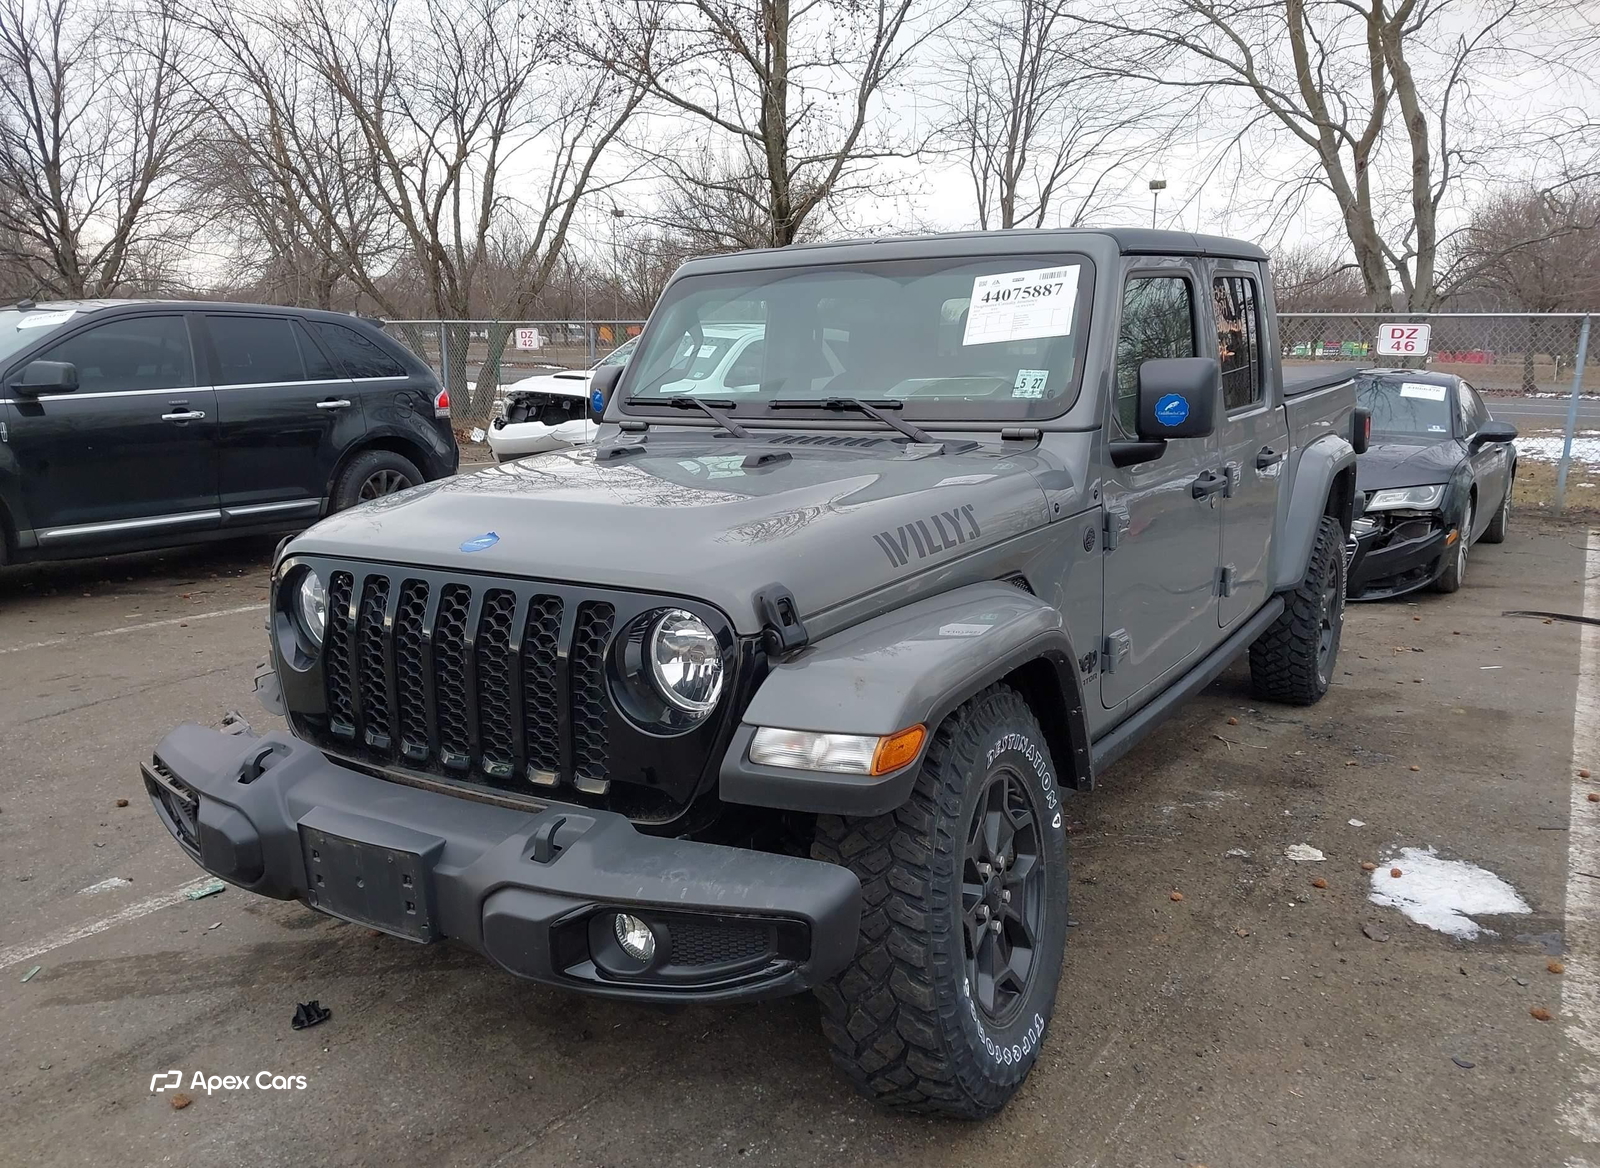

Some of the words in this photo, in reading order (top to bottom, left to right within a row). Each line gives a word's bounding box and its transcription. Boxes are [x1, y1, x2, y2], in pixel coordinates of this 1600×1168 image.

[981, 282, 1063, 303] 44075887
[520, 331, 534, 339] DZ
[1391, 328, 1419, 340] DZ
[521, 339, 533, 347] 42
[1390, 340, 1416, 352] 46
[1019, 377, 1027, 389] 5
[1031, 377, 1044, 389] 27
[872, 503, 981, 568] WILLYS
[985, 733, 1058, 810] DESTINATION
